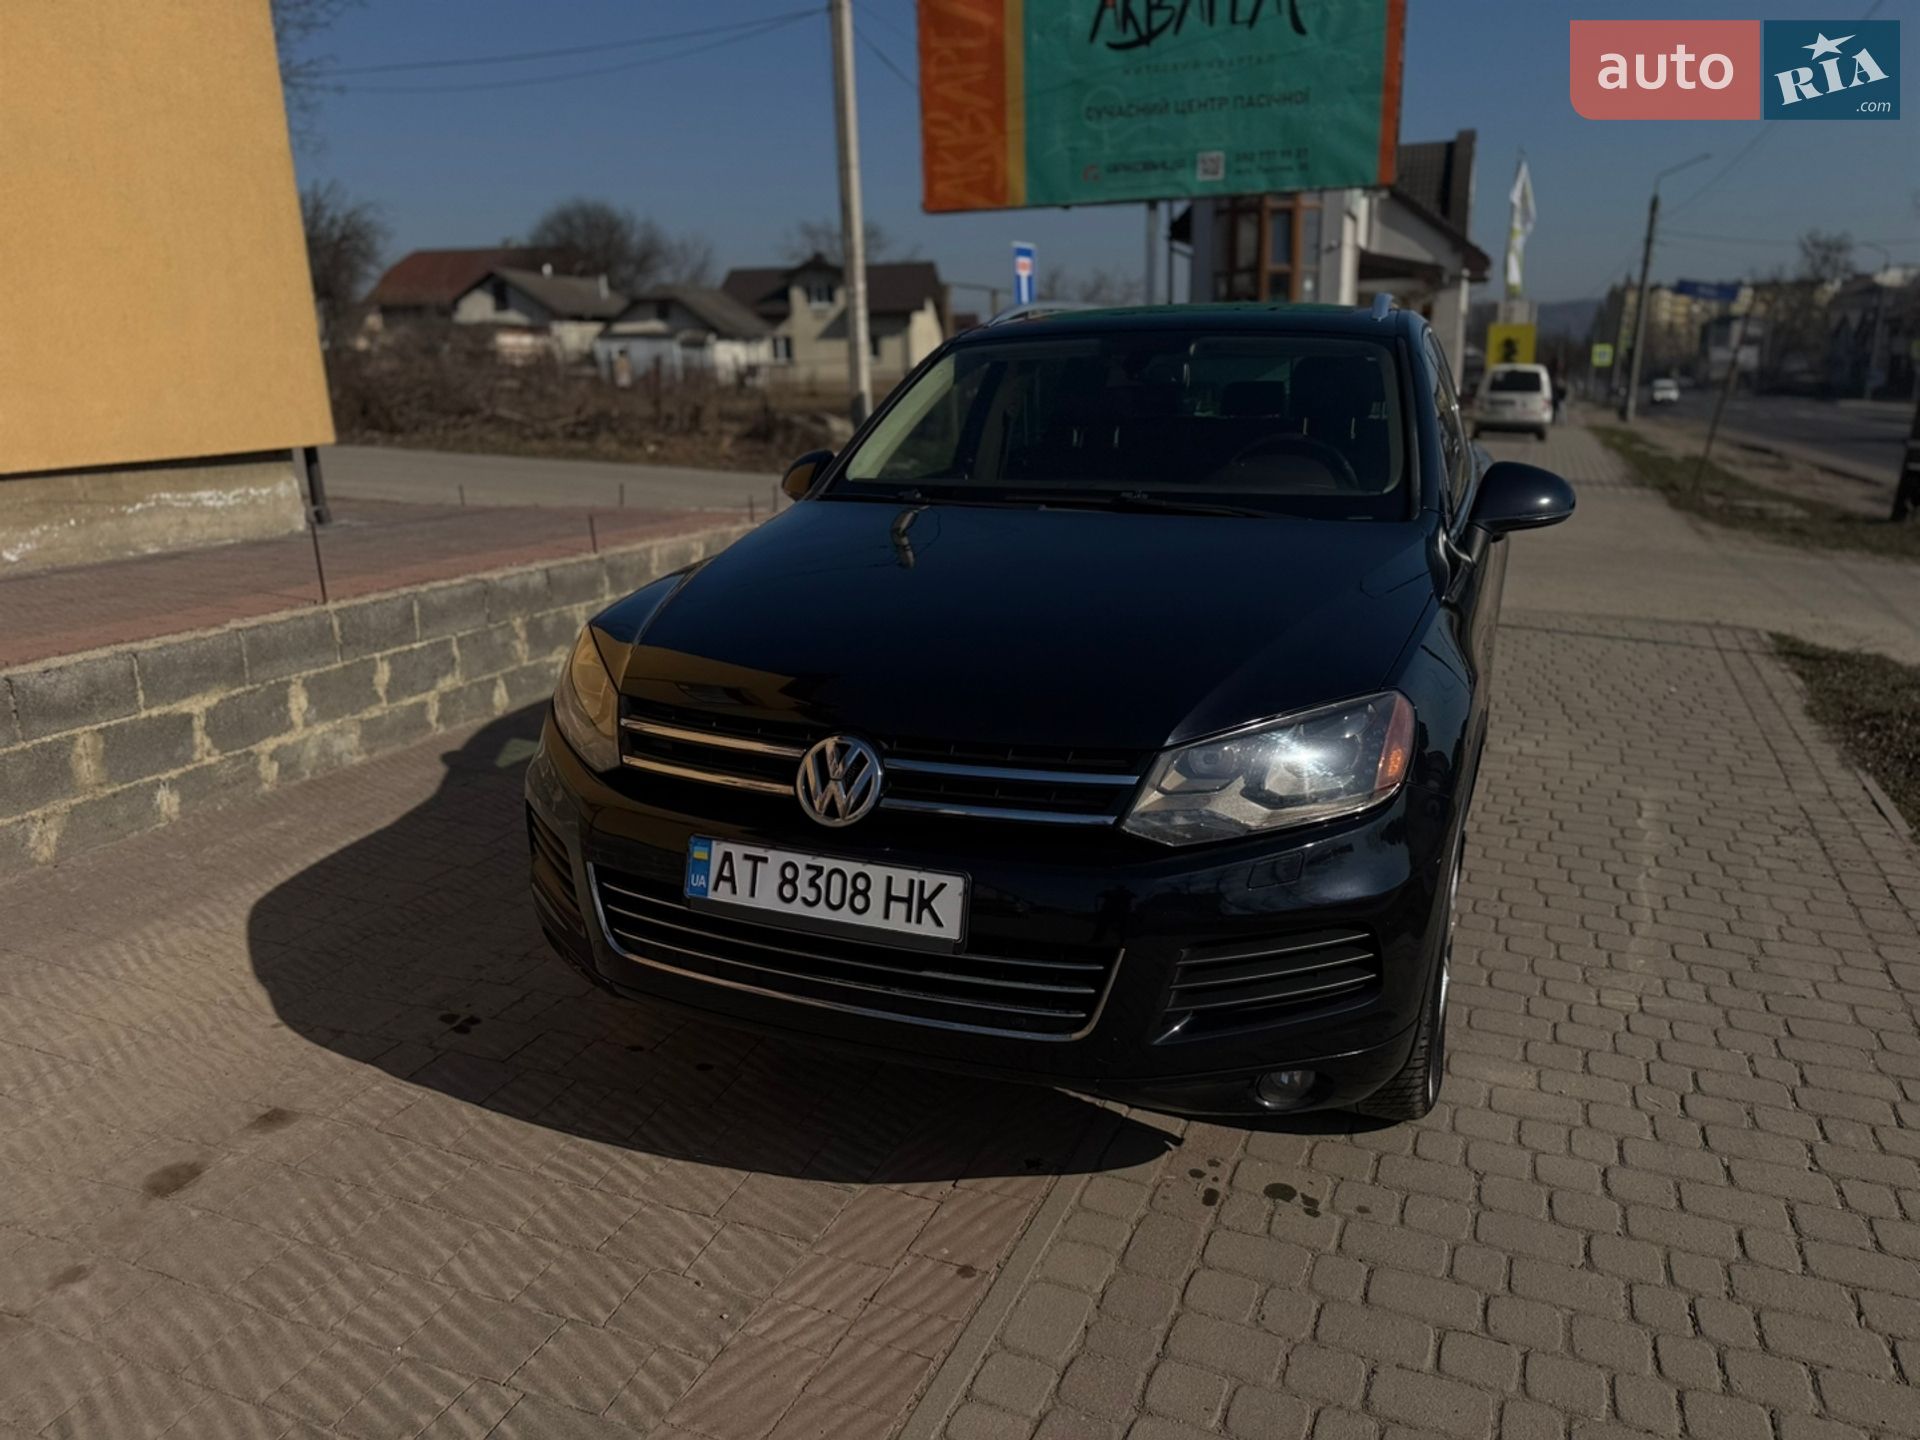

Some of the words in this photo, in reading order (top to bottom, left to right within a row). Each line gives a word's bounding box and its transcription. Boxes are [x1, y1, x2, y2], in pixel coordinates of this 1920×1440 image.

[1085, 97, 1169, 121] СУЧАСНИЙ
[1174, 95, 1229, 116] ЦЕНТР
[691, 874, 707, 888] UA
[712, 851, 769, 898] AT
[777, 861, 872, 915] 8308
[883, 875, 948, 928] HK
